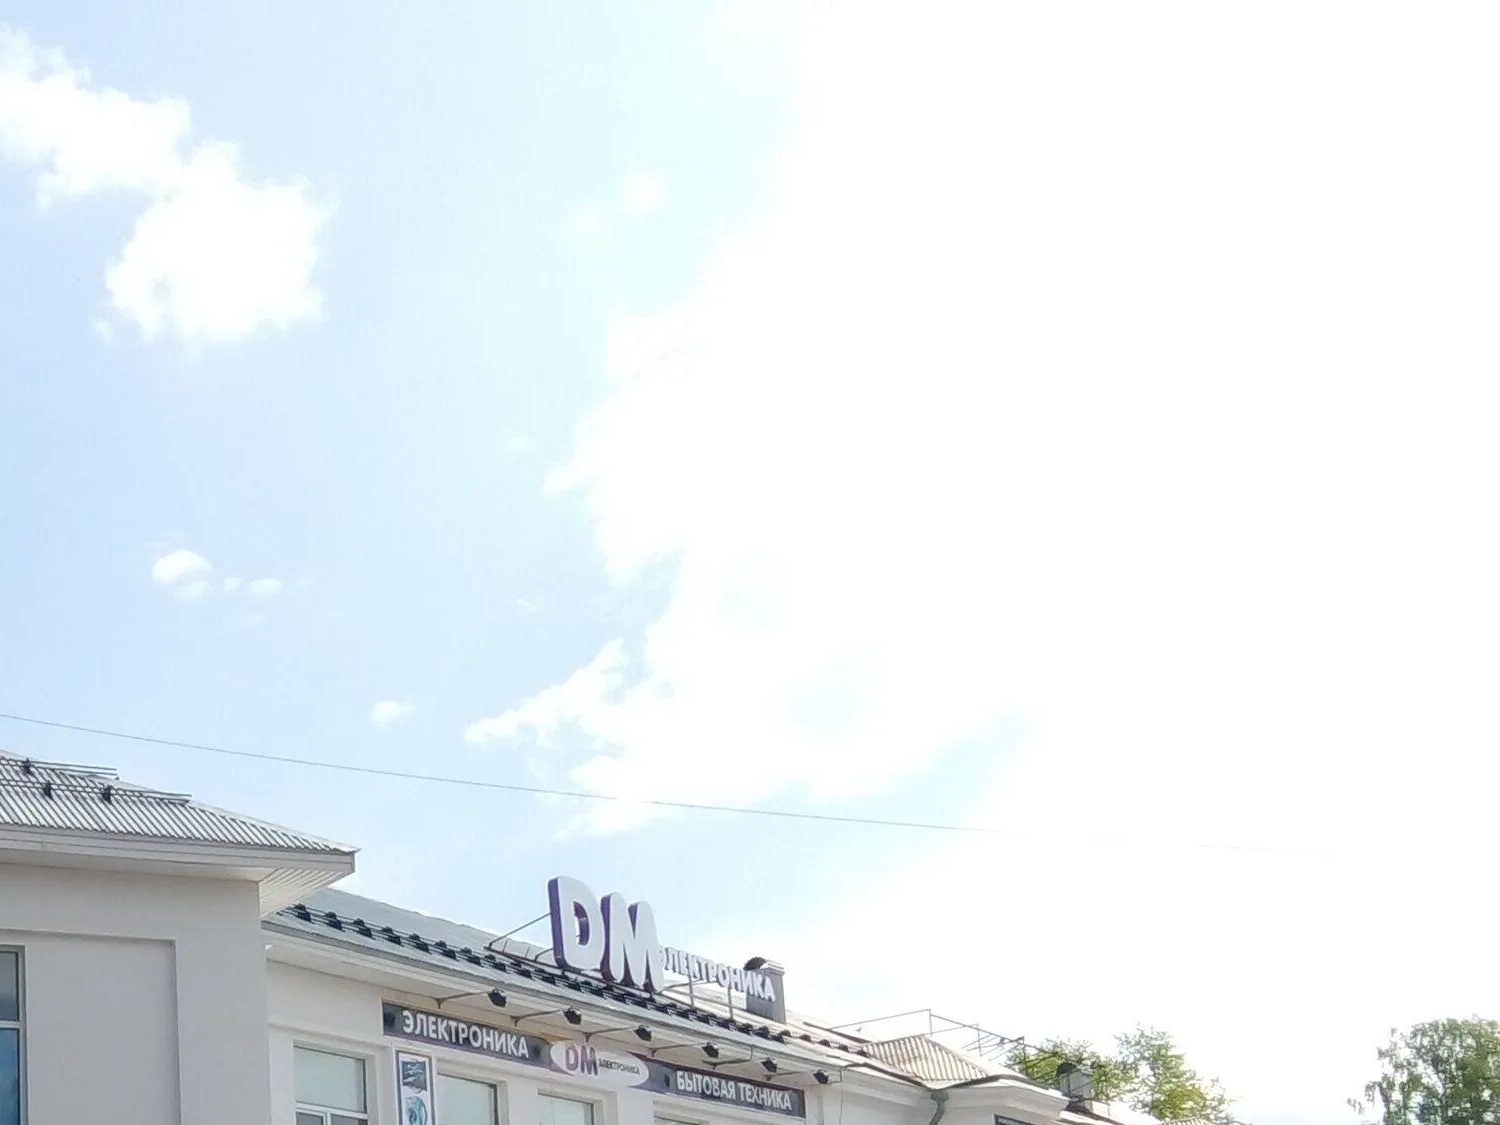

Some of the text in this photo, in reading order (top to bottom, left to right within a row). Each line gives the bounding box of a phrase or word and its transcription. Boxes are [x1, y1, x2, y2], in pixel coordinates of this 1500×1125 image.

[547, 876, 664, 994] DM
[402, 1009, 530, 1059] ЭЛЕКТРОНИКА
[565, 1045, 598, 1076] DM
[676, 1069, 793, 1111] БЫТОВАЯ ТЕХНИКА
